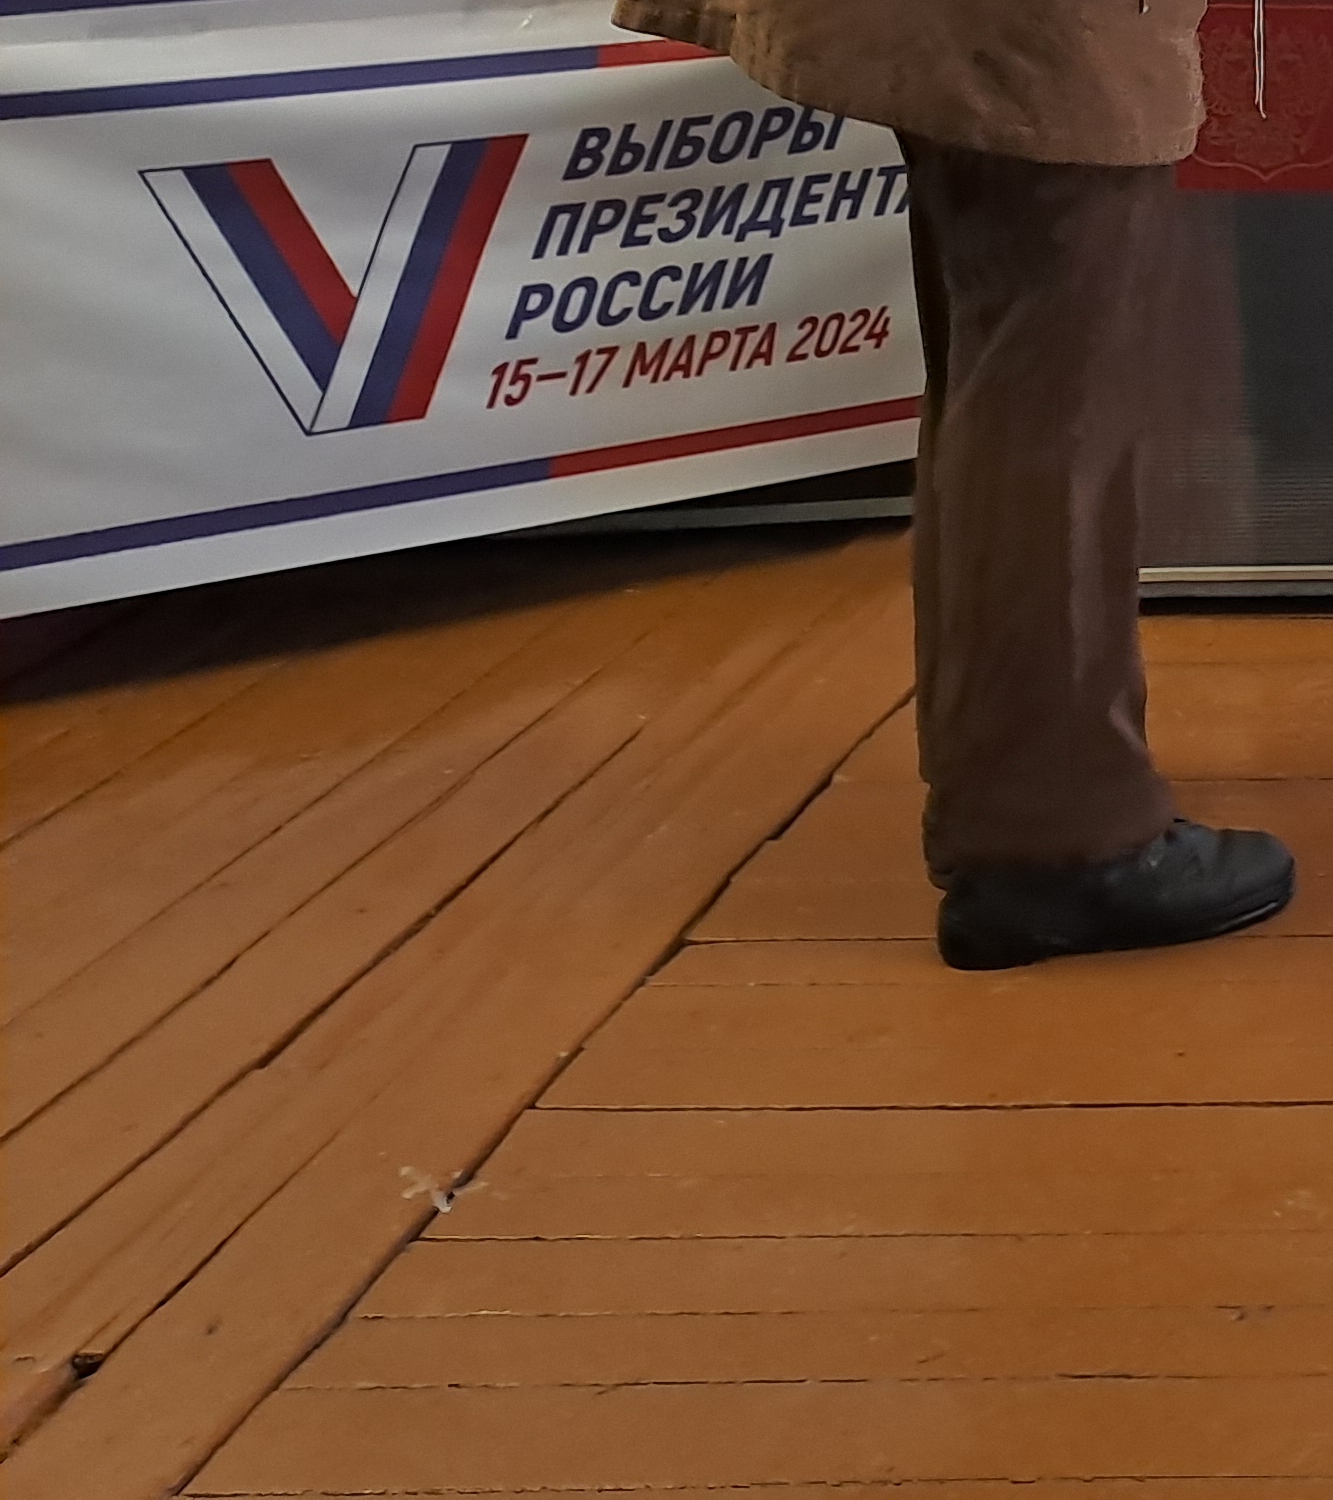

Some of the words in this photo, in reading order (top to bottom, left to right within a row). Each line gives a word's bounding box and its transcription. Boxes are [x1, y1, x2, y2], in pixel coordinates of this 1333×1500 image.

[561, 104, 846, 182] ВЫБОРЫ
[504, 252, 775, 341] РОССИИ
[485, 343, 623, 410] 15–17
[621, 321, 776, 389] МАРТА
[784, 304, 891, 364] 2024
